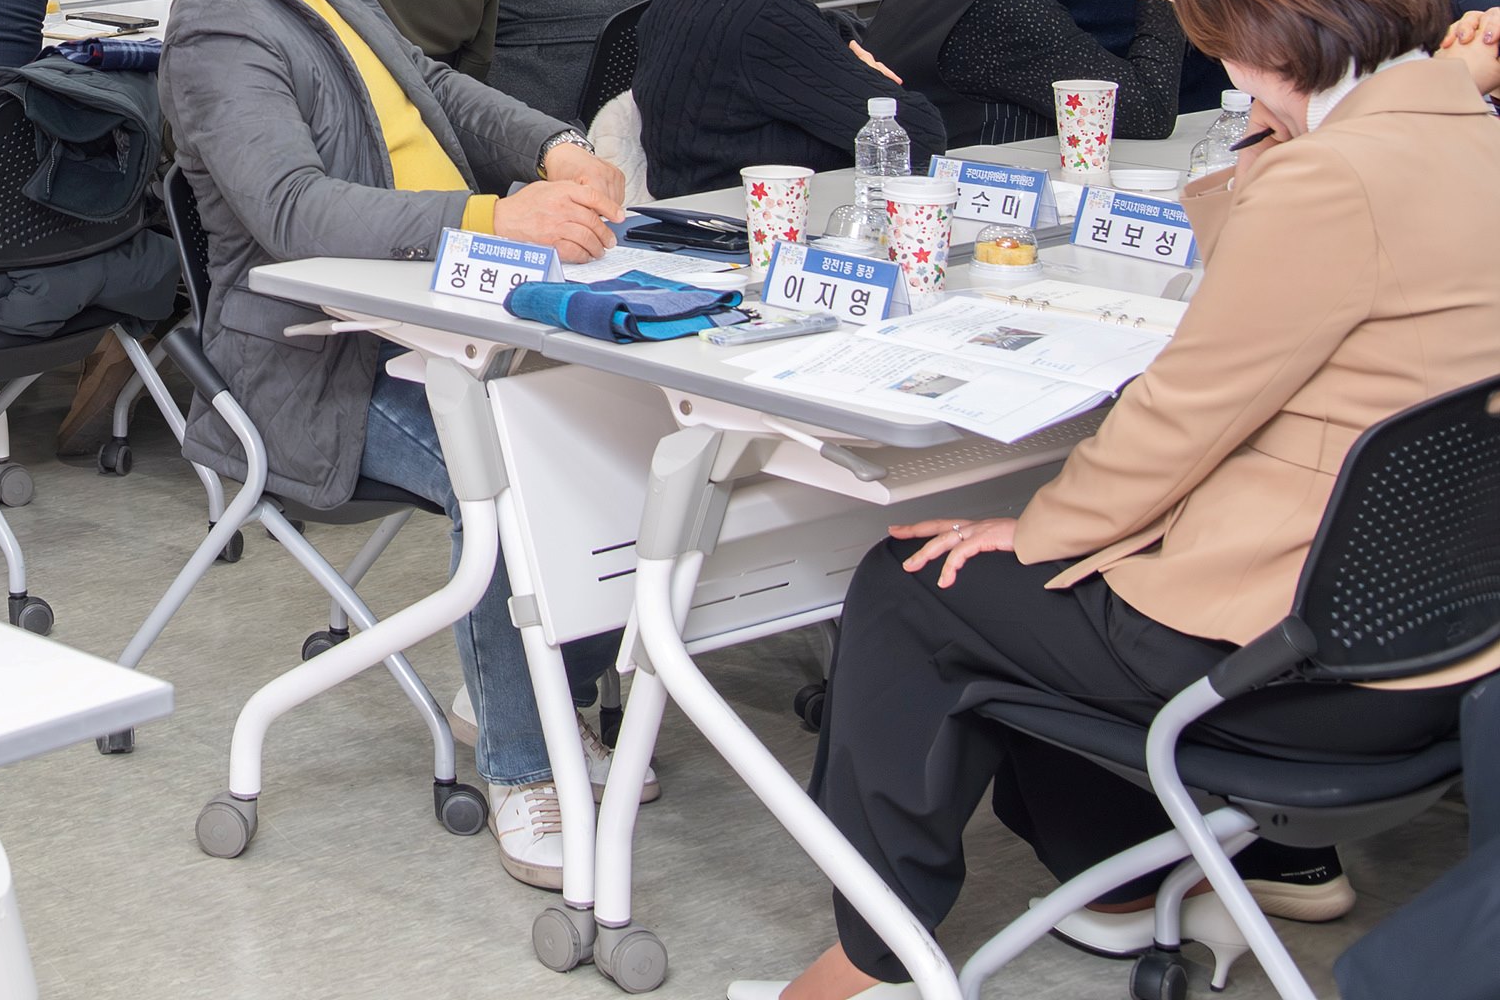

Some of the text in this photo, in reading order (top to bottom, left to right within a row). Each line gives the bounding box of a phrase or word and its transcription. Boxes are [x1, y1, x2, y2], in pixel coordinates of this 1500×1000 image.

[965, 168, 1008, 183] 주민자치위원회
[953, 188, 1021, 219] 수미
[1113, 199, 1161, 218] 주민자치위원회
[1091, 217, 1177, 256] 권보성
[471, 241, 521, 261] 주민자치위원회
[523, 250, 547, 265] 위원장
[821, 257, 875, 279] 장전1동 동장
[784, 275, 871, 317] 이지영
